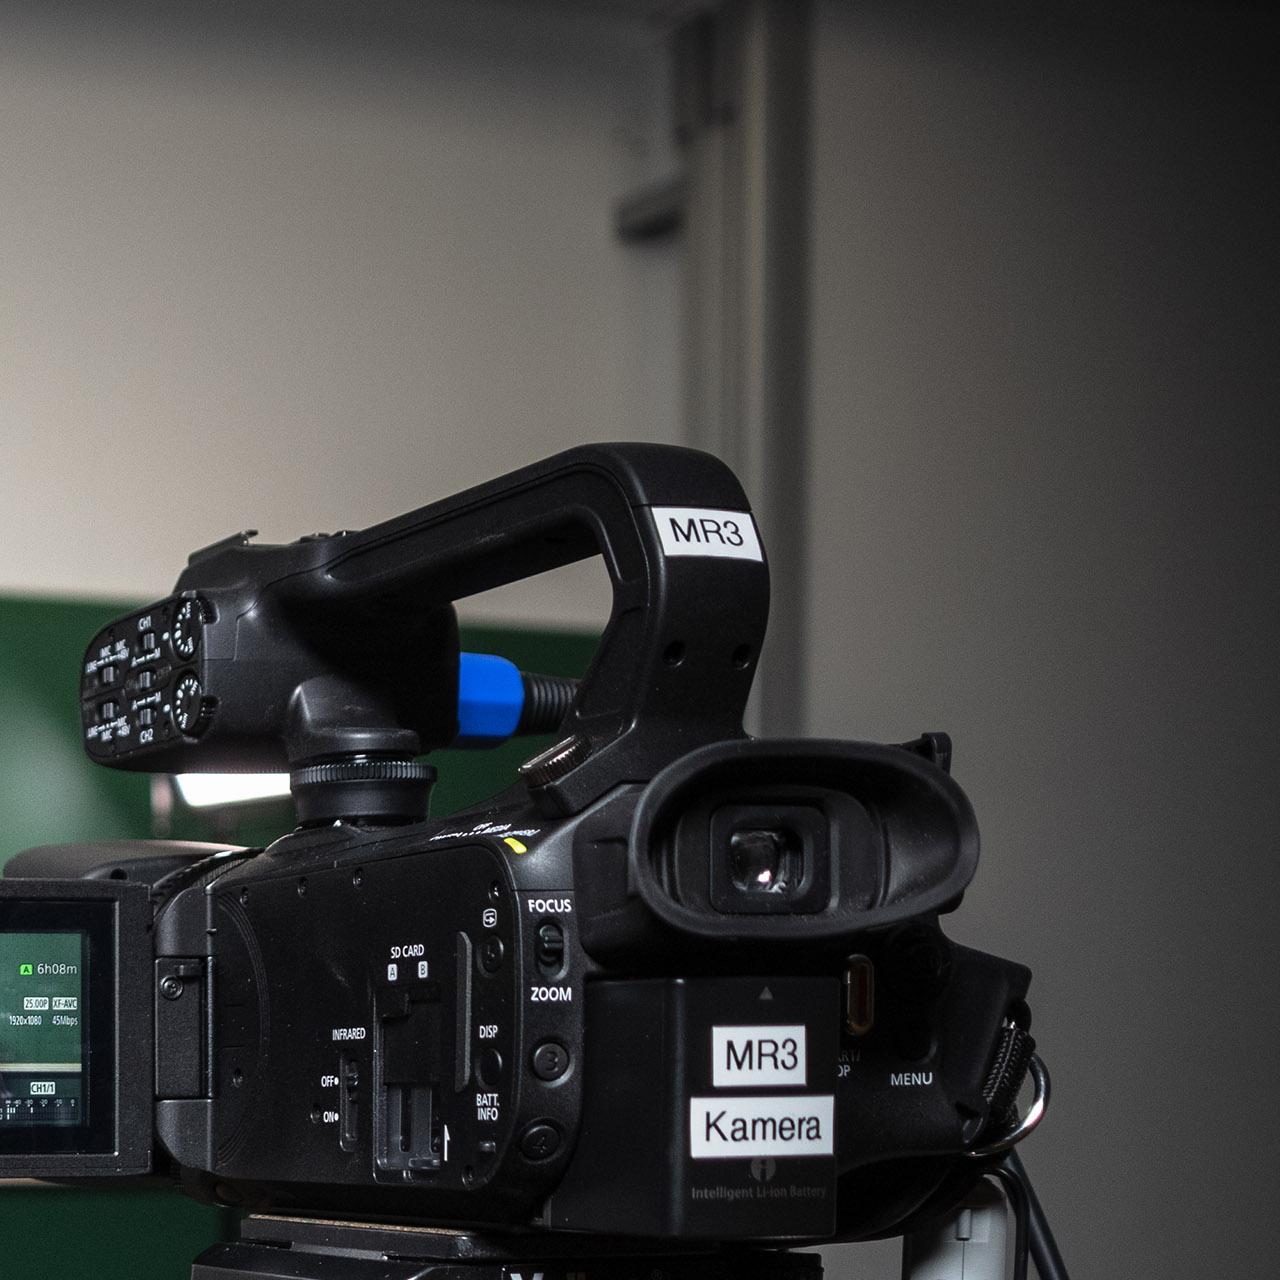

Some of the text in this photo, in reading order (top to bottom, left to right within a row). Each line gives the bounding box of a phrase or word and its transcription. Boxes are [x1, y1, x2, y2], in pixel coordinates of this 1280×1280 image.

[668, 517, 744, 546] MR3
[138, 616, 152, 631] CH1
[140, 729, 154, 744] CH2
[528, 899, 572, 913] FOCUS
[390, 944, 425, 959] SD CARD
[37, 963, 77, 974] 6h08m
[531, 987, 573, 1002] ZOOM
[25, 999, 77, 1008] 25.00P XF-AVC
[332, 1028, 366, 1041] INFRARED
[479, 1025, 499, 1039] DISP
[726, 1038, 799, 1070] MR3
[321, 1076, 334, 1087] OFF
[891, 1072, 933, 1086] MENU
[31, 1083, 54, 1093] CH1/1
[476, 1093, 500, 1107] BATT.
[323, 1111, 335, 1123] ON
[477, 1108, 499, 1121] INFO
[705, 1110, 822, 1142] Kamera
[692, 1187, 754, 1200] Intelligent
[790, 1185, 826, 1199] Battery
